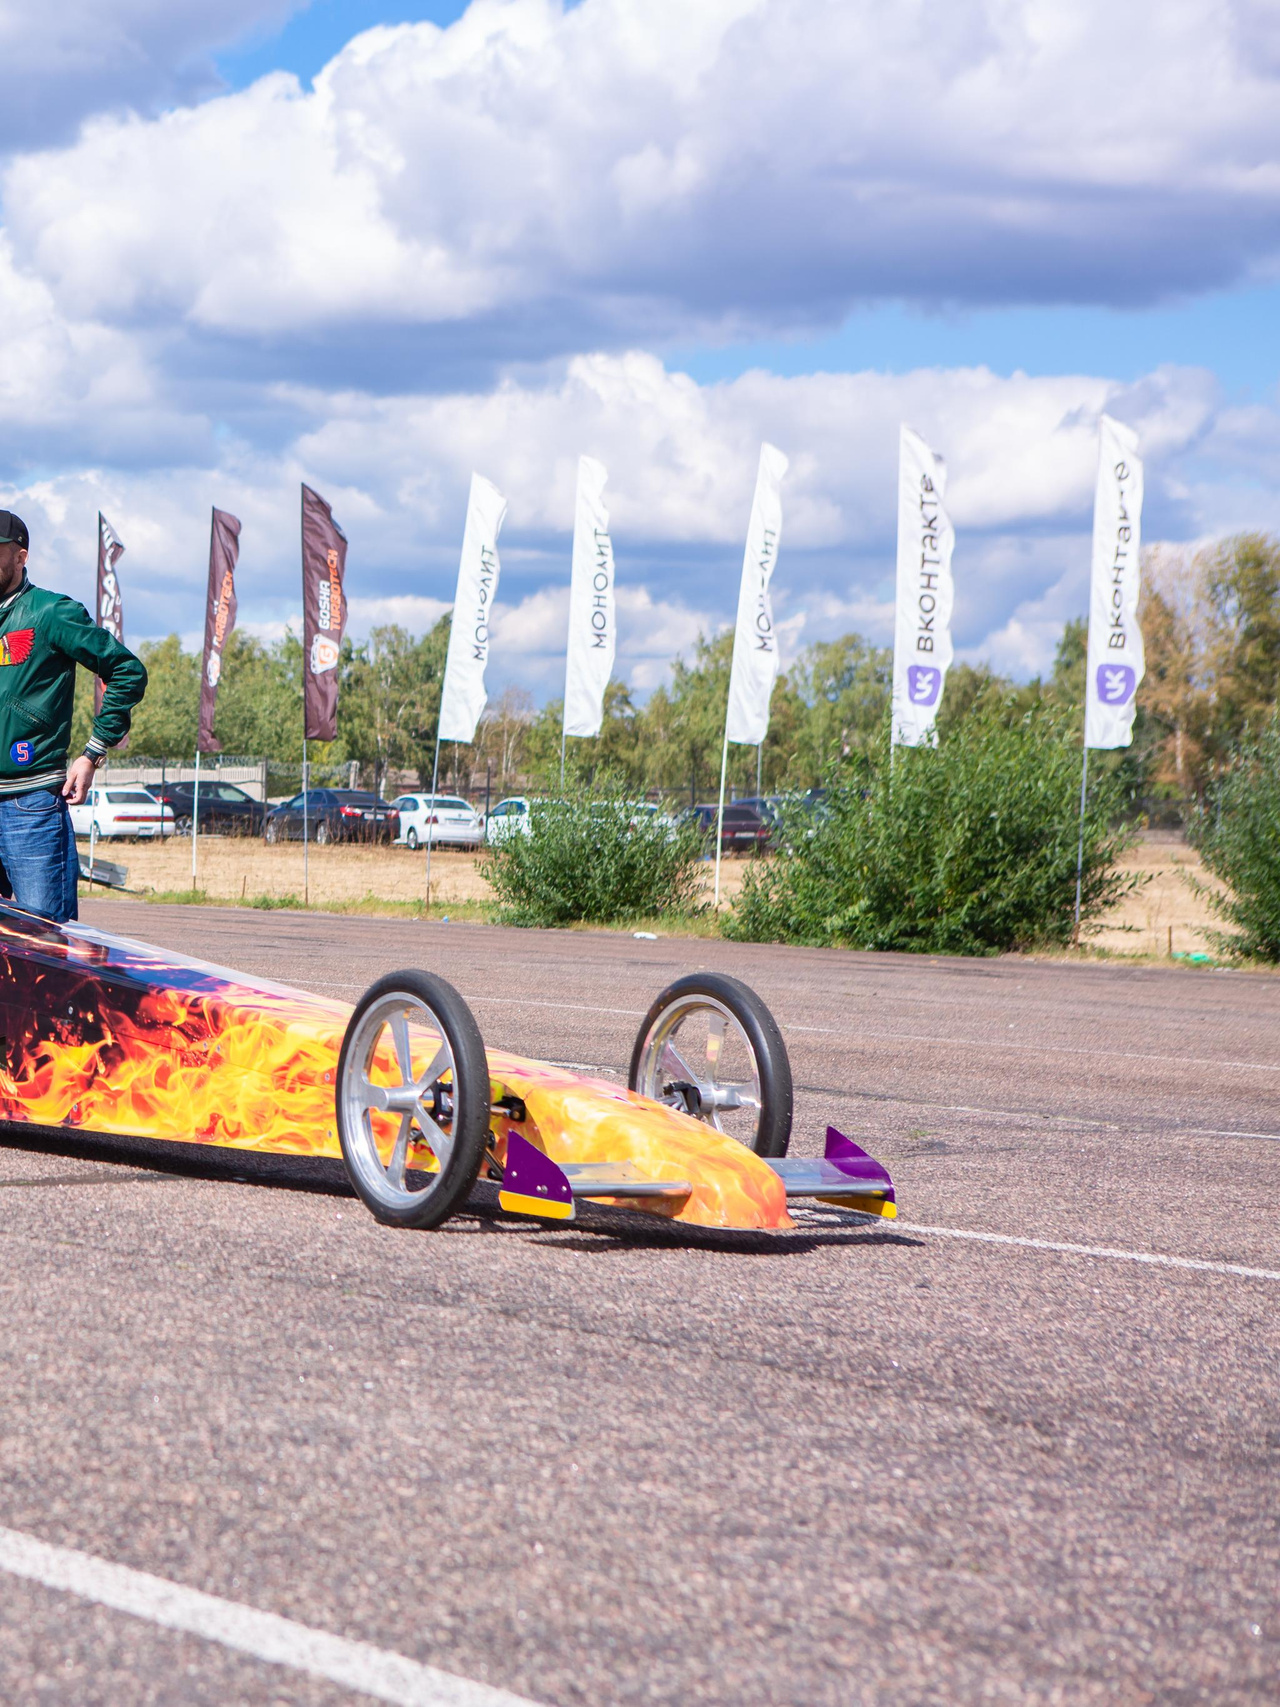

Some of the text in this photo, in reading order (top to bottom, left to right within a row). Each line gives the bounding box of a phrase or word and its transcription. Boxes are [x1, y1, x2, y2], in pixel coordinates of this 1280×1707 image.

[318, 579, 331, 631] GOSHA
[327, 549, 342, 631] TURBOTECH
[590, 528, 609, 649] МОНОЛИТ
[16, 742, 29, 762] 5
